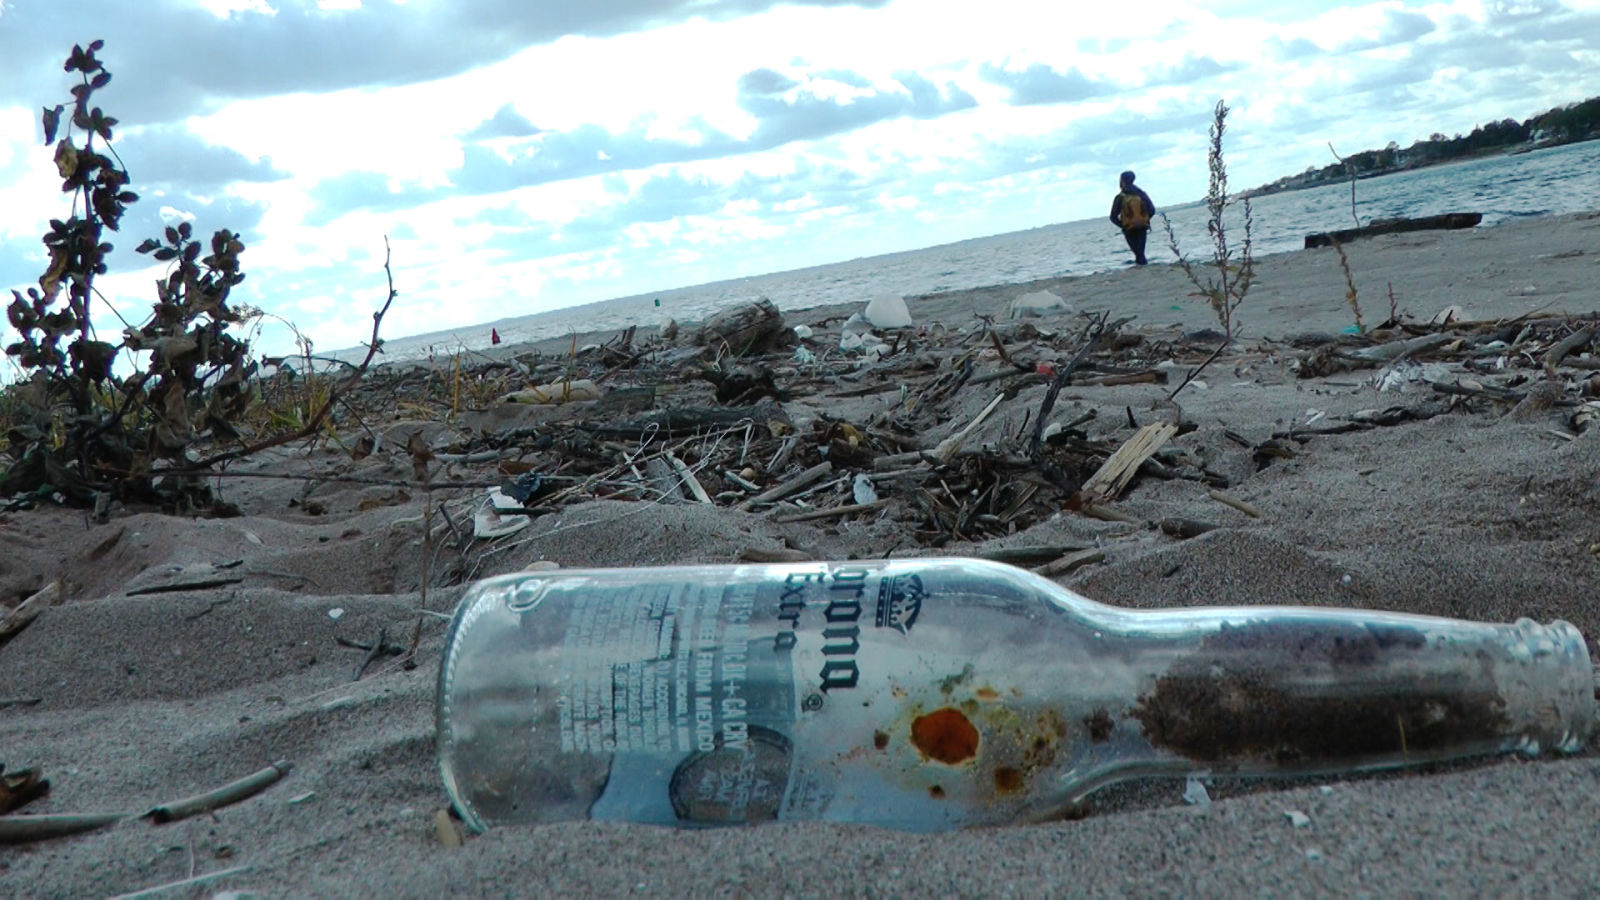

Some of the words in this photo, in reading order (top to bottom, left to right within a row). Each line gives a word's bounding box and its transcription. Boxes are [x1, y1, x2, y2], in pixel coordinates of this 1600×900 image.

[819, 568, 869, 694] orona
[695, 652, 714, 692] FROM
[615, 689, 627, 710] THE
[722, 698, 748, 719] CA
[695, 696, 716, 752] MEXICO
[723, 721, 749, 751] CRV
